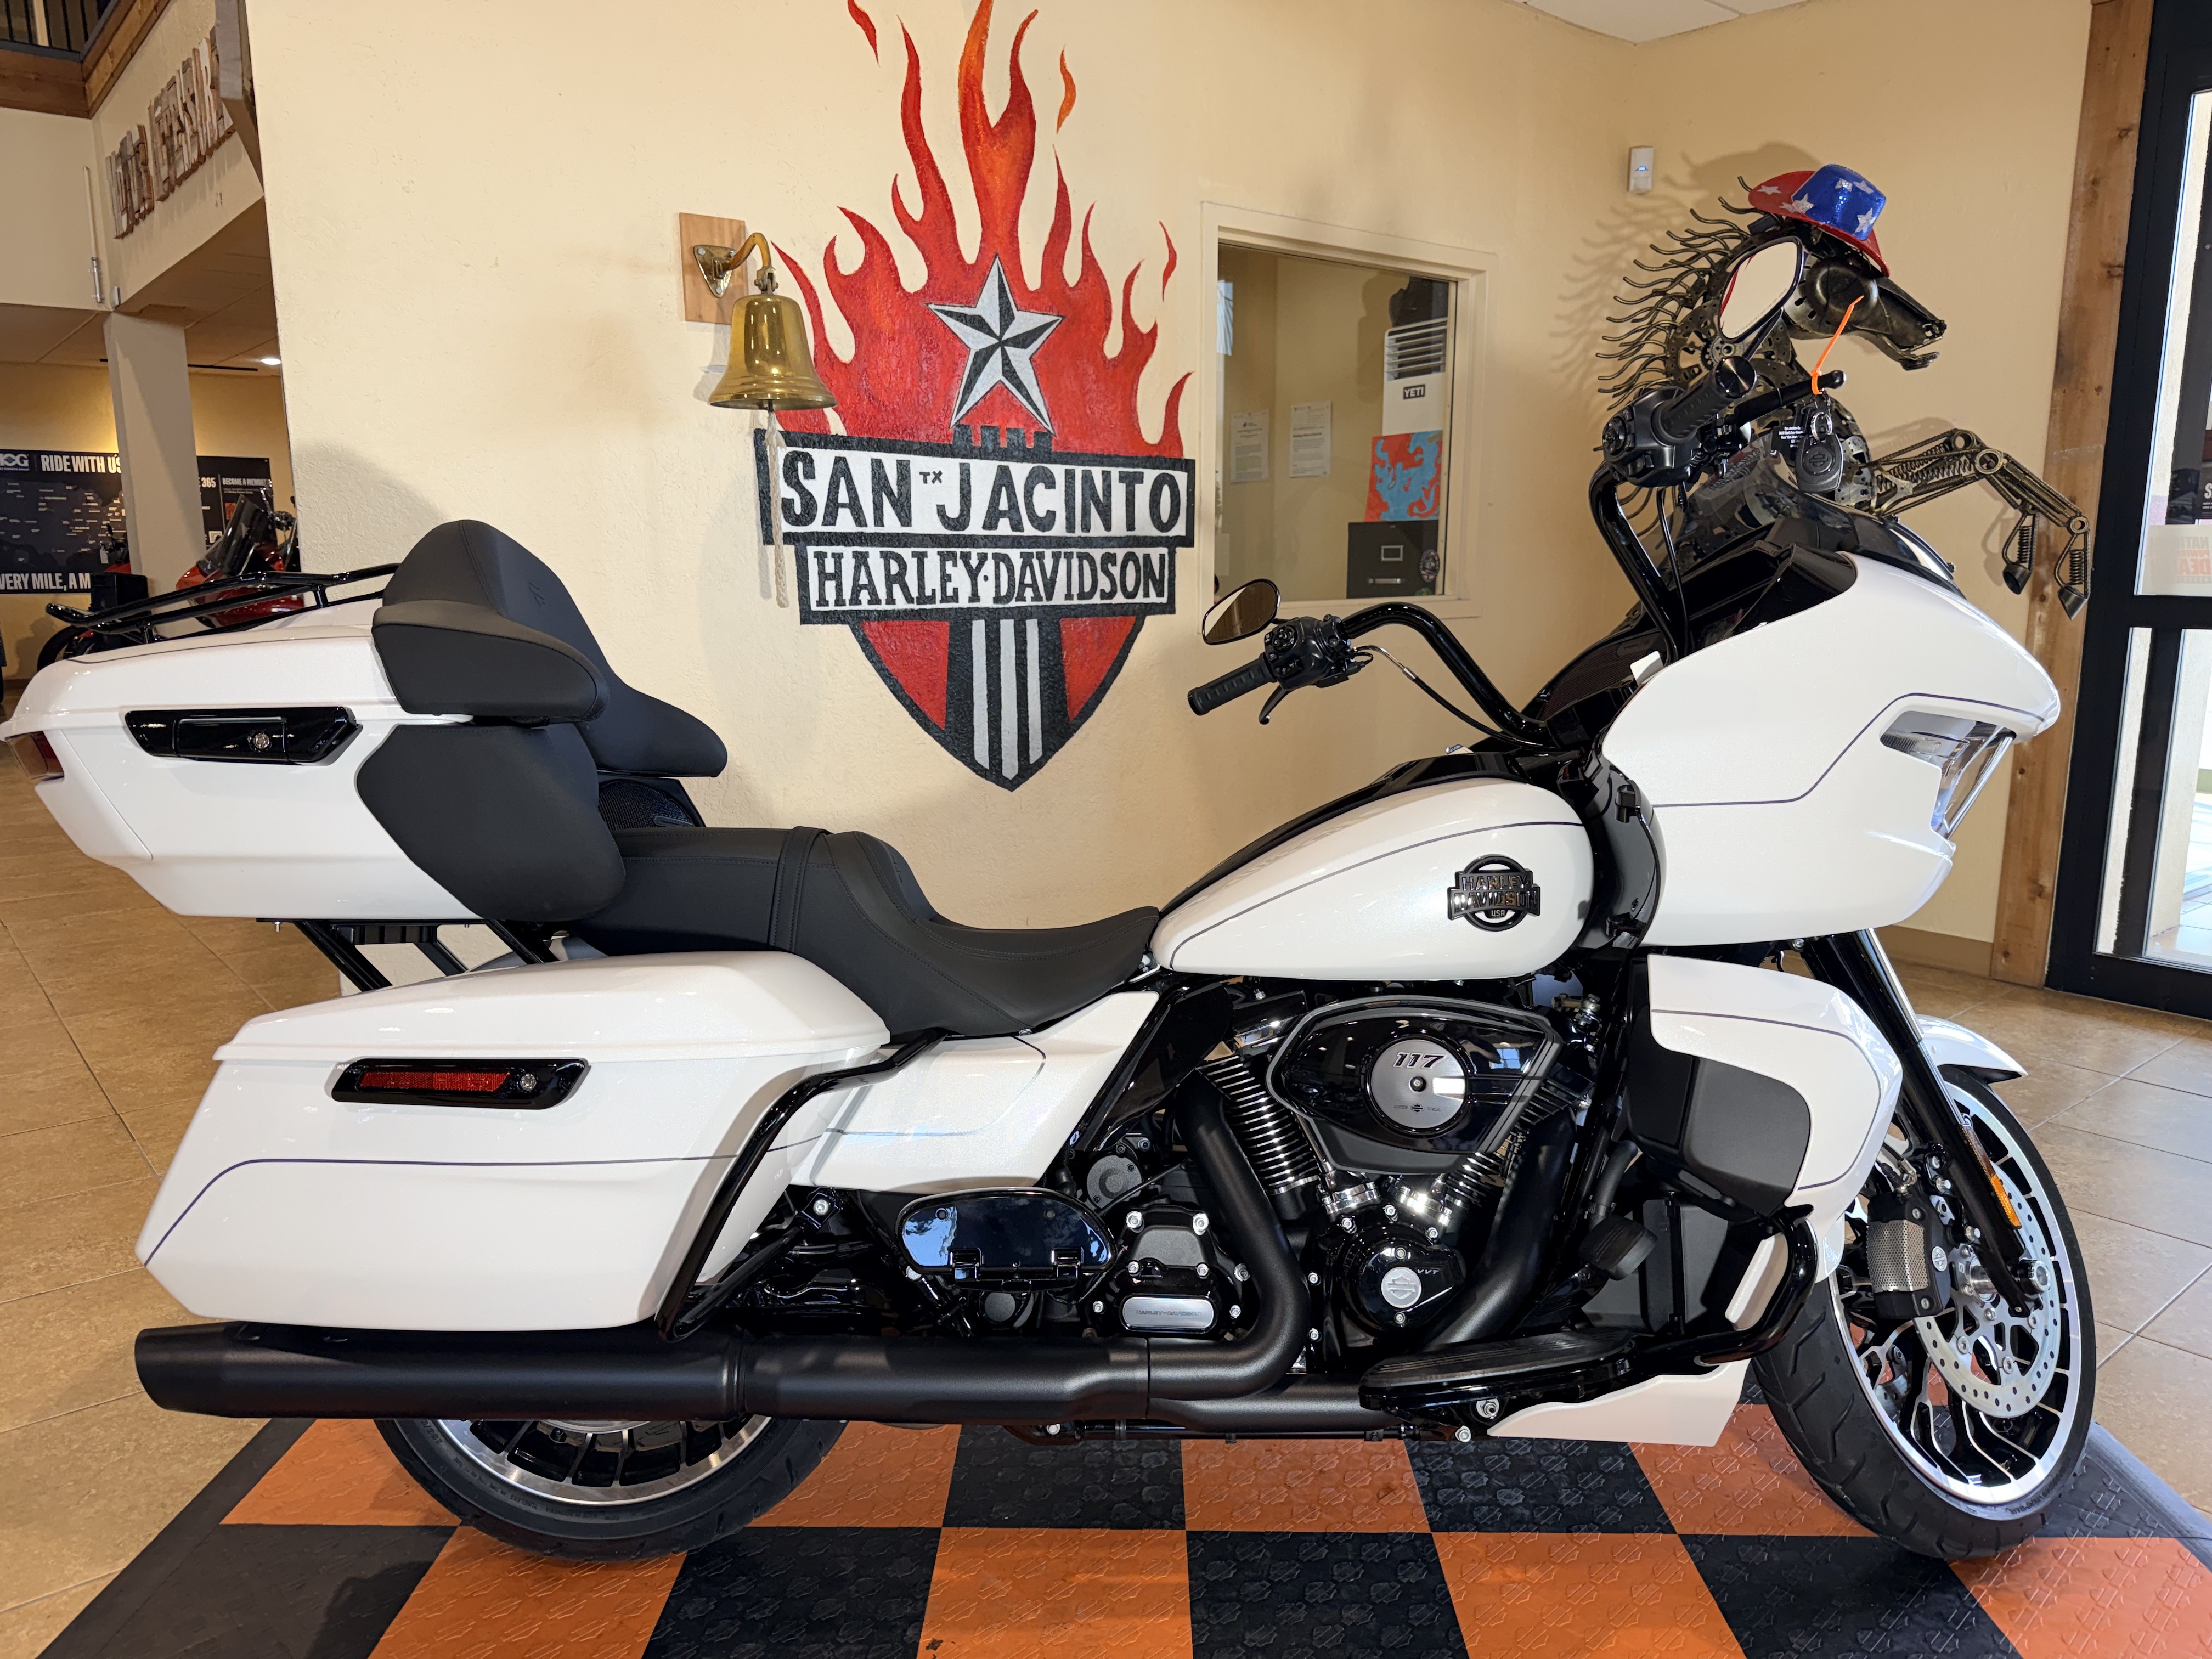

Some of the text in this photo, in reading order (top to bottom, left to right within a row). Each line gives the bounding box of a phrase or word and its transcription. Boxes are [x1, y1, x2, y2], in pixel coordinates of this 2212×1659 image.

[1404, 386, 1424, 398] YETI
[41, 454, 71, 472] RIDE
[71, 455, 106, 473] WITH
[201, 477, 216, 488] 365
[222, 477, 242, 486] BECOME
[781, 450, 1181, 533] SAN TX JACINTO
[31, 573, 67, 591] MILE,
[69, 572, 78, 589] A
[1393, 1052, 1447, 1070] 117
